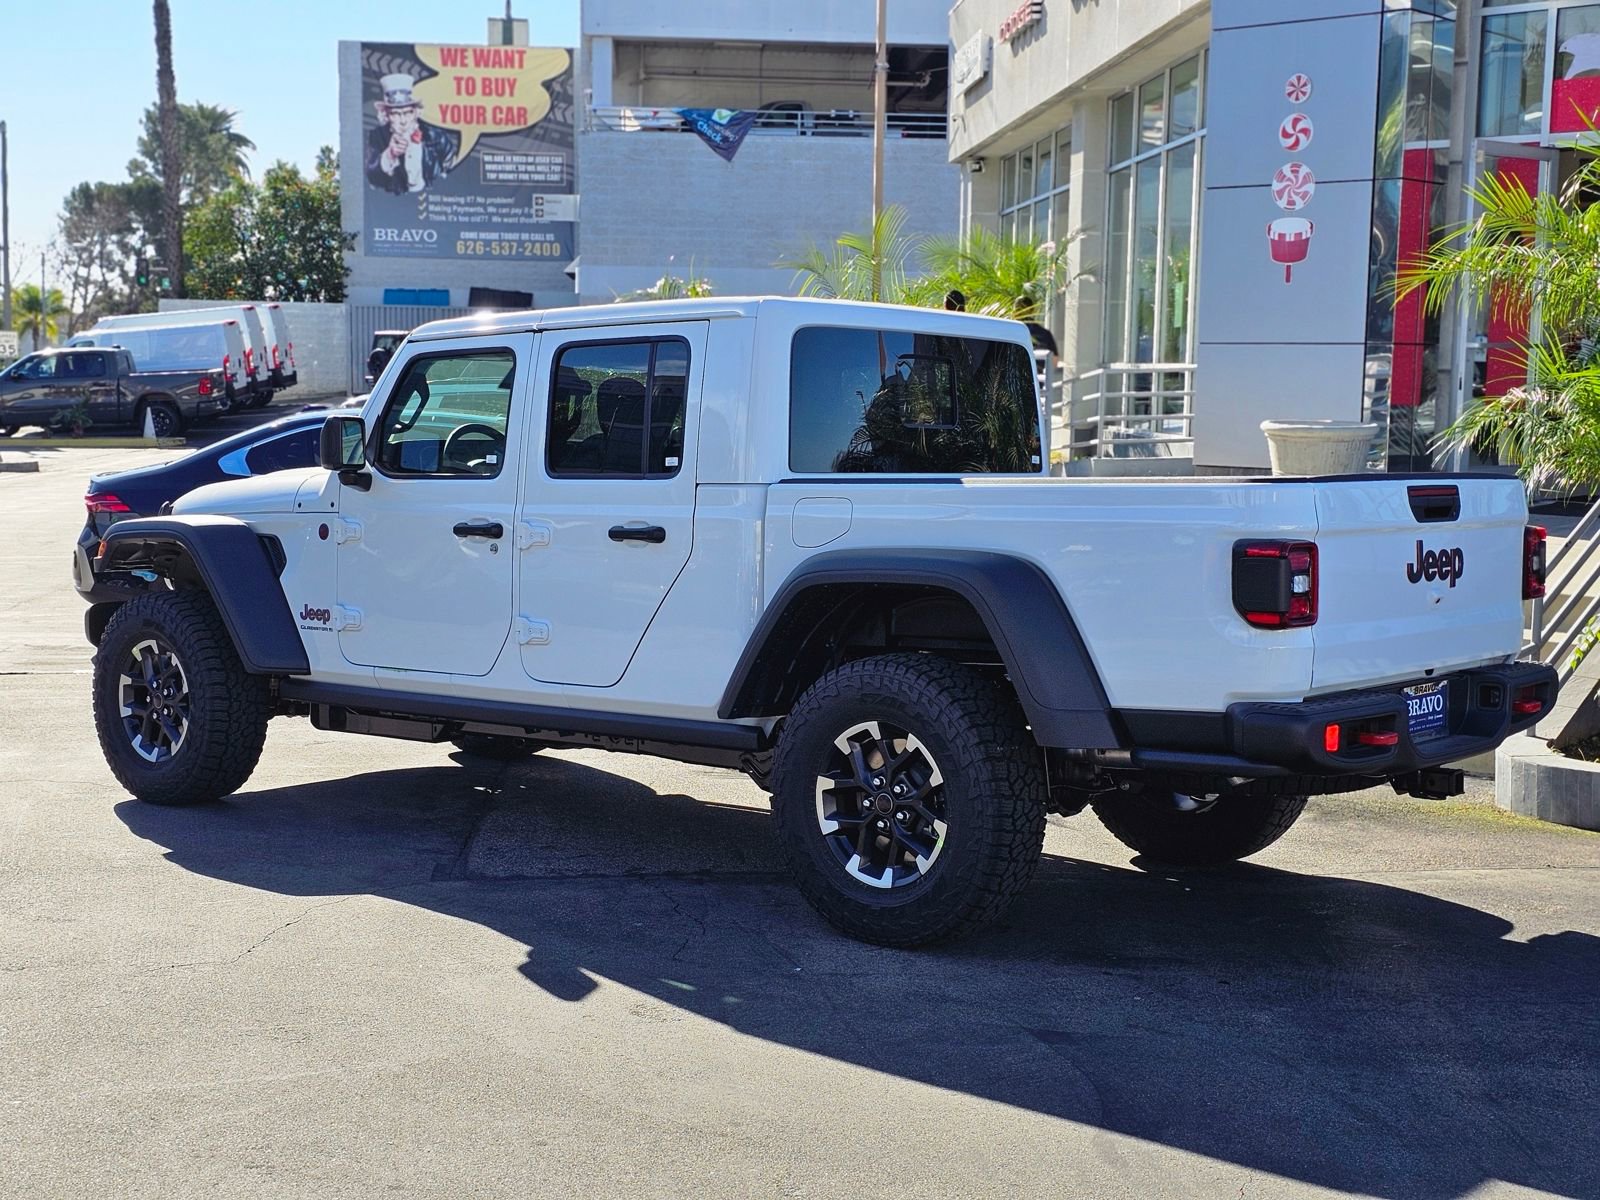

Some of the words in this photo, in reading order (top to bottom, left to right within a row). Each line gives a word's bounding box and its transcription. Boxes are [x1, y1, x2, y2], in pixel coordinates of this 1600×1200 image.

[998, 0, 1033, 43] DODGE
[440, 47, 468, 68] WE
[472, 48, 526, 69] WANT
[453, 76, 476, 96] TO
[481, 77, 517, 97] BUY
[438, 104, 487, 125] YOUR
[492, 105, 528, 126] CAR
[428, 204, 451, 213] Making
[511, 207, 522, 215] pay
[373, 228, 438, 242] BRAVO
[456, 240, 561, 257] 626-537-2400
[0, 344, 16, 355] 35
[1406, 539, 1464, 588] Jeep
[300, 603, 331, 625] Jeep
